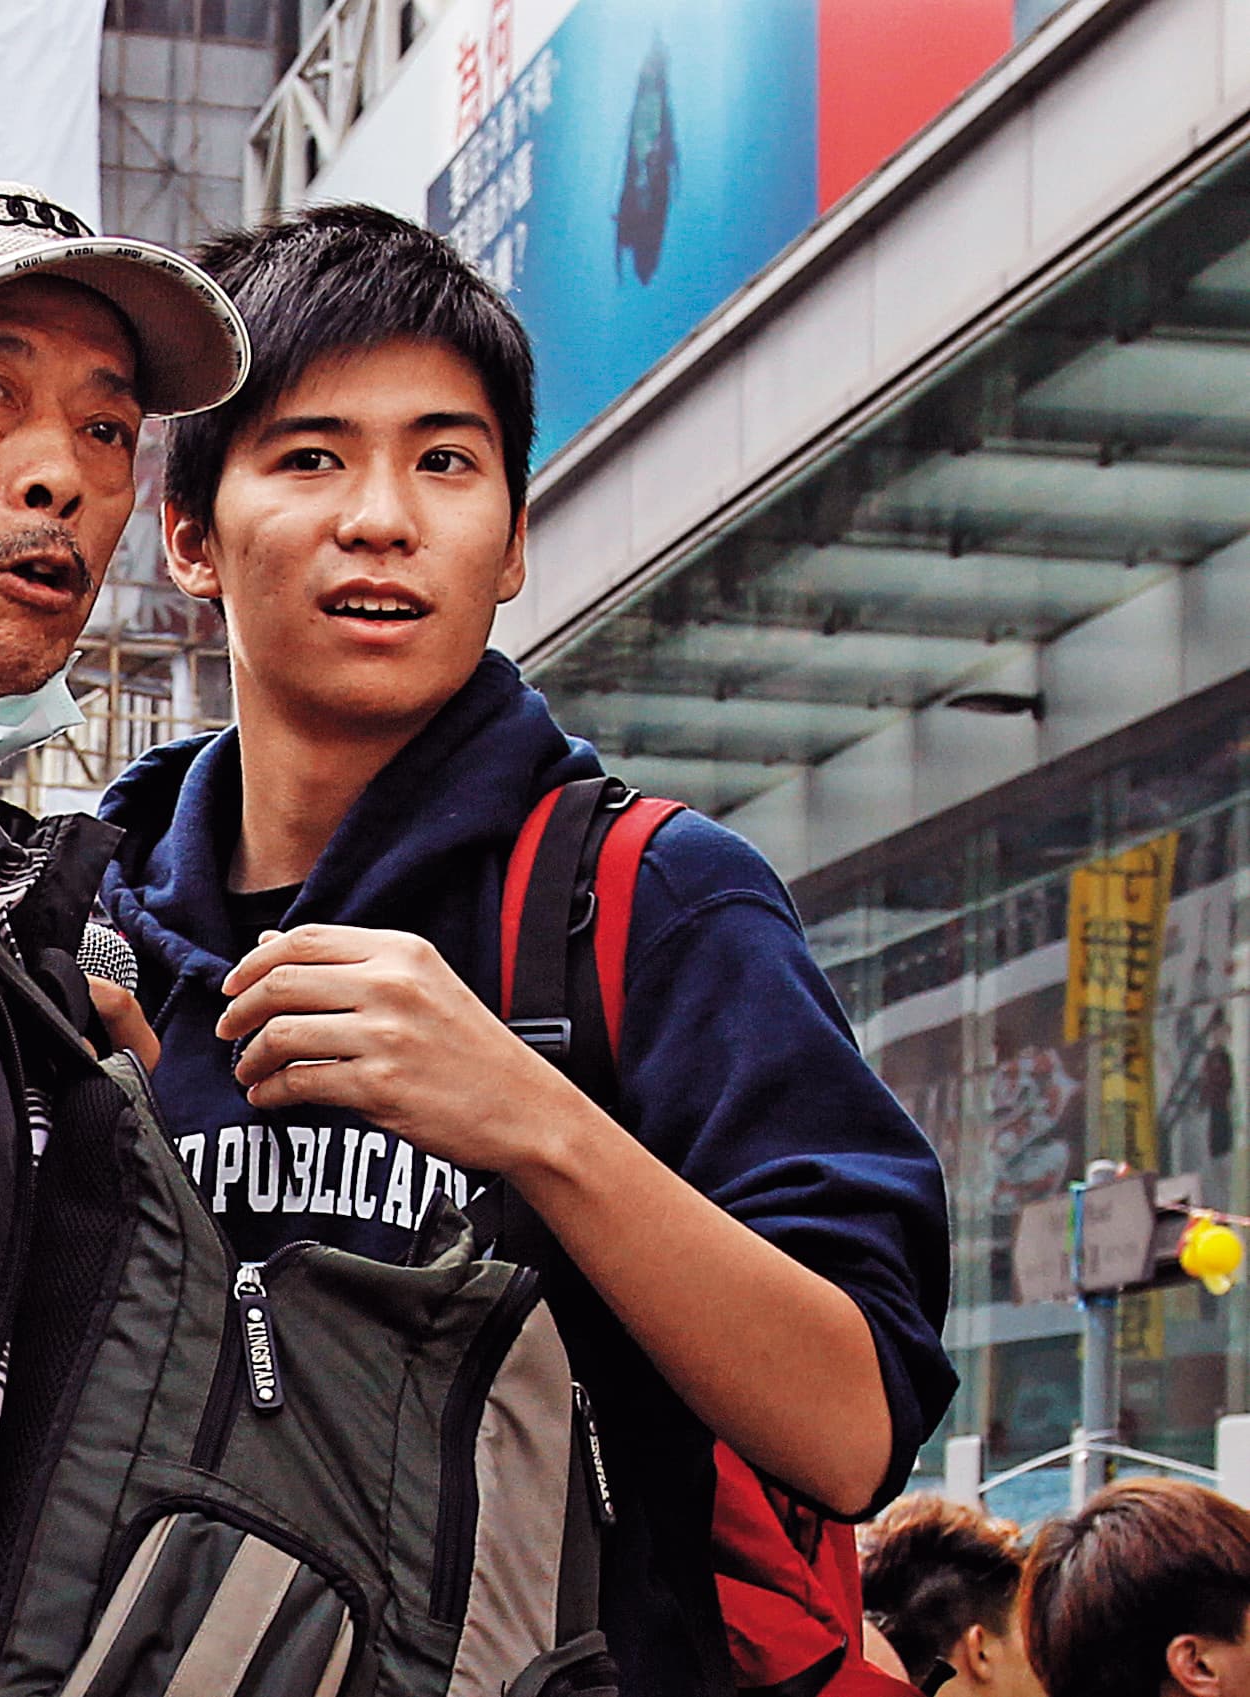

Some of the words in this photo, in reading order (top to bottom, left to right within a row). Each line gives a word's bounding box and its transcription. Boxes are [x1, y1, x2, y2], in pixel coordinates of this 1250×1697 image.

[65, 247, 94, 257] AUDI
[115, 247, 142, 259] AUDI
[247, 1321, 275, 1391] KINGSTAR
